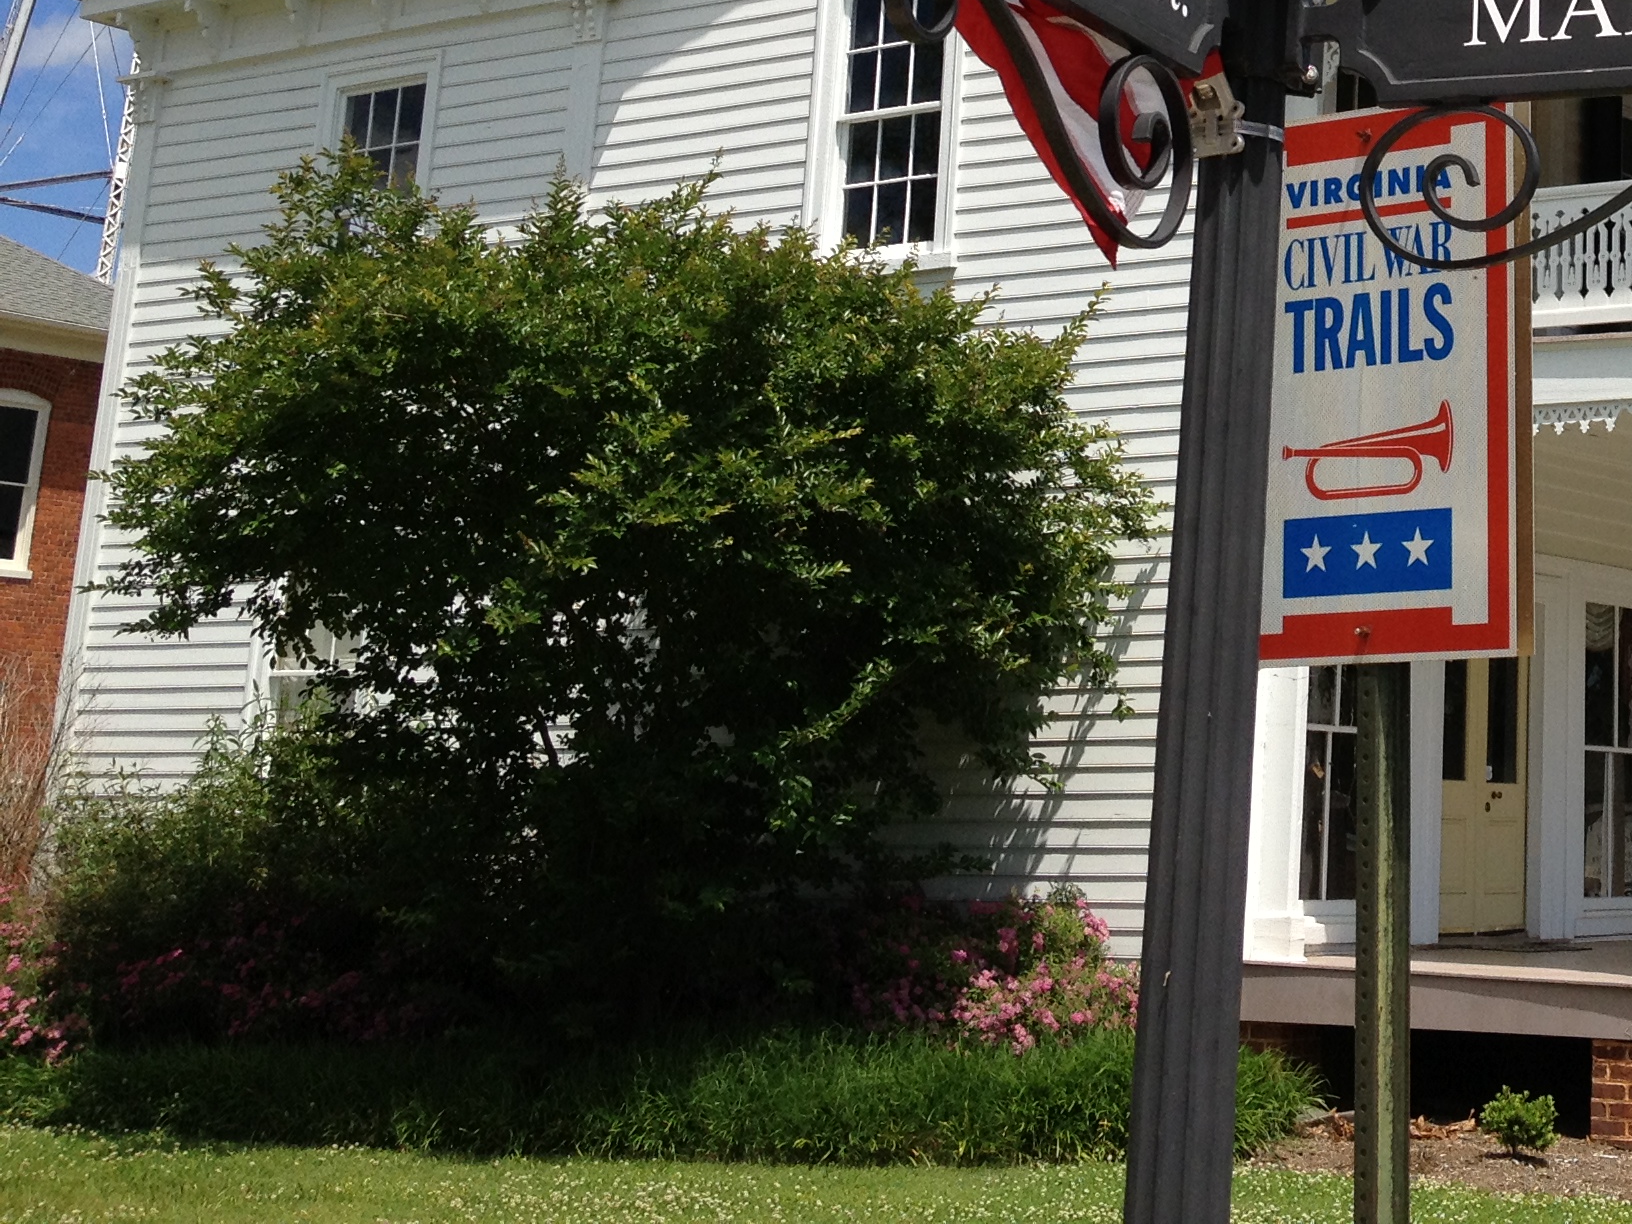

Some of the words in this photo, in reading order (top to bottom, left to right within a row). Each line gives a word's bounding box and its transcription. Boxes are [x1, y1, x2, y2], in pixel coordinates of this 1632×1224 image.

[1285, 163, 1452, 210] VIRGINIA
[1283, 230, 1376, 291] CIVIL
[1382, 220, 1453, 280] WAR
[1284, 282, 1455, 375] TRAILS
